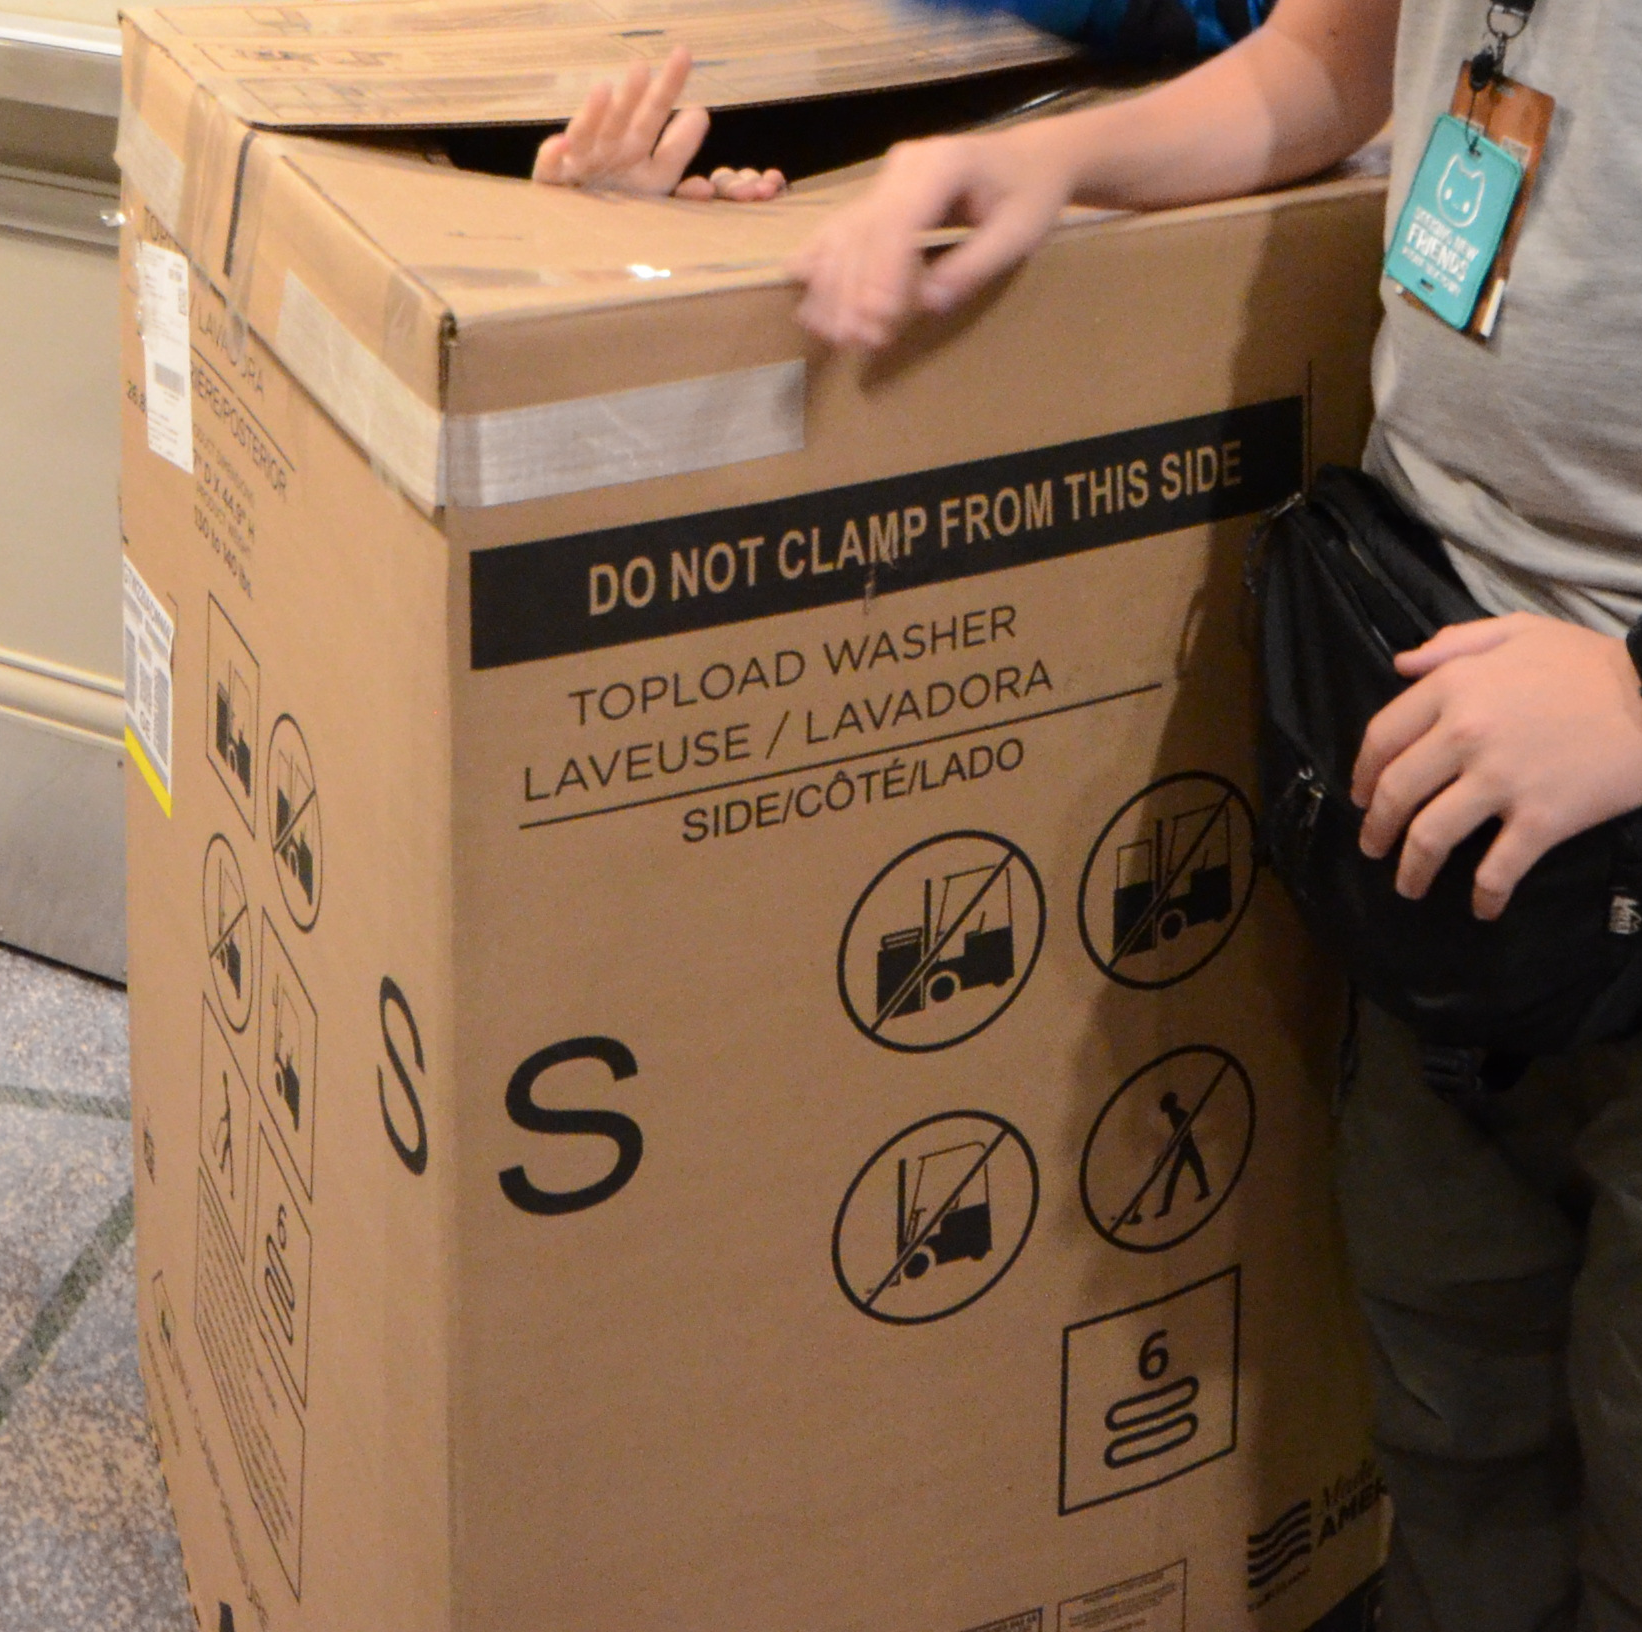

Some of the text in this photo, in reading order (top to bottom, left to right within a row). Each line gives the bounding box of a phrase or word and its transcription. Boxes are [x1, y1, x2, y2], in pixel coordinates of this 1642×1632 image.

[588, 440, 1243, 616] DO NOT CLAMP FROM THIS SIDE
[524, 722, 751, 802] LAVEUSE
[806, 659, 1054, 745] LAVADORA
[567, 605, 1018, 726] TOPLOAD WASHER
[681, 736, 1025, 843] SIDE/CÔTÉ/LADO
[376, 975, 428, 1176] S
[499, 1035, 644, 1216] S
[1137, 1328, 1169, 1382] 6
